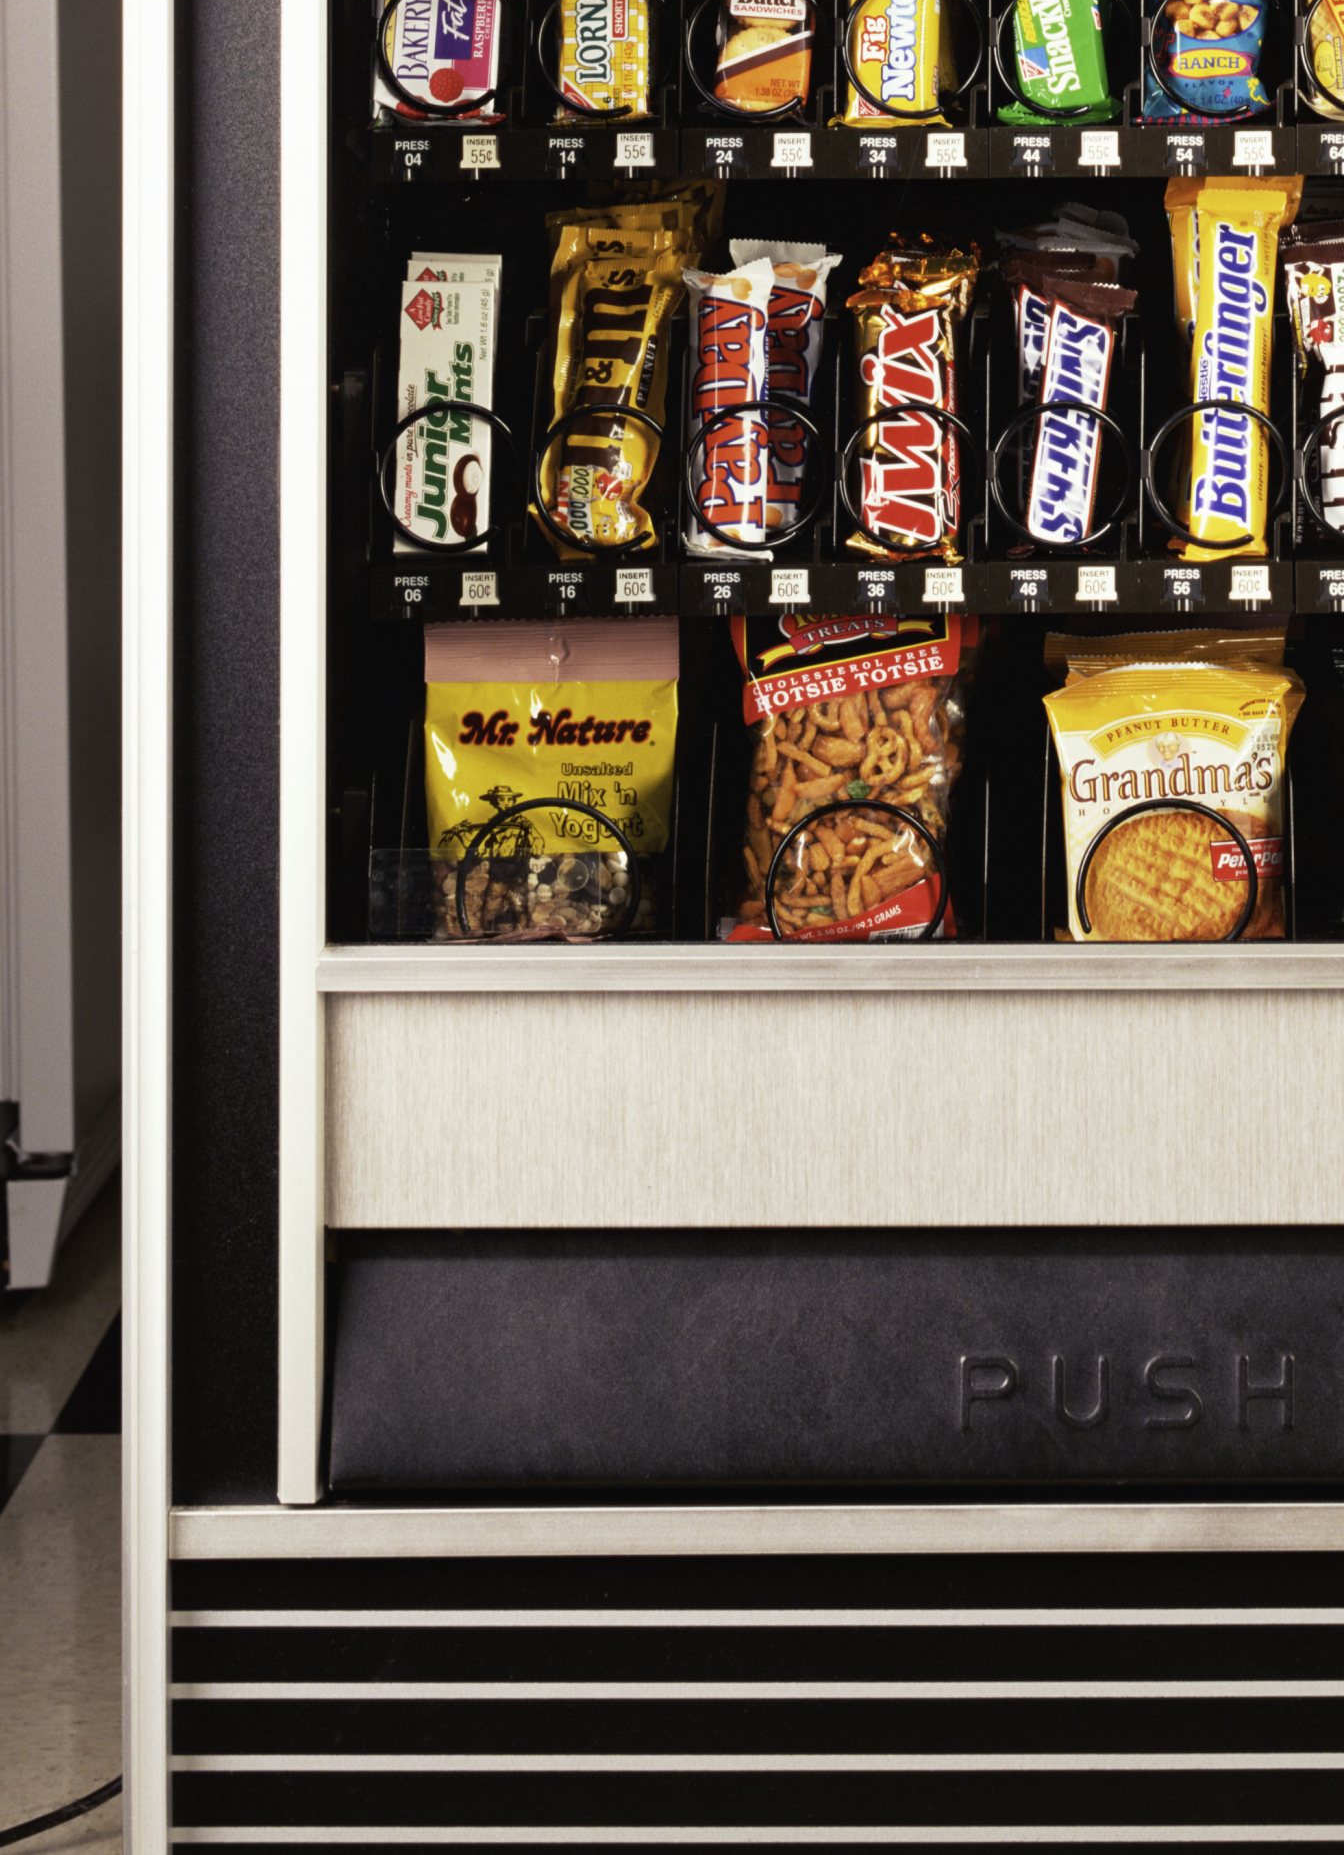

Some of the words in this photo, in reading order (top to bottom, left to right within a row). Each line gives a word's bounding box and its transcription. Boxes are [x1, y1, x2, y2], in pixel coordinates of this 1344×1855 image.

[733, 3, 804, 16] SANDWICHES
[860, 16, 888, 63] Fig
[448, 341, 474, 446] Mnts
[1195, 222, 1268, 528] Butterfinger
[417, 369, 451, 541] Junior
[704, 573, 740, 582] PRESS
[714, 585, 731, 598] 26
[773, 573, 802, 581] INSERT
[778, 583, 799, 597] 60¢
[803, 619, 885, 643] TREATS
[753, 659, 883, 695] CHOLESTEROL
[895, 647, 939, 662] FREE
[755, 678, 847, 713] HOTSIE
[855, 656, 943, 686] TOTSIE
[458, 711, 517, 746] Mr.
[530, 709, 652, 745] Nature
[1107, 720, 1162, 742] PEANUT
[1172, 718, 1231, 735] BUTTER
[561, 762, 633, 776] Unsalted
[1069, 752, 1275, 802] Grandma's
[960, 1354, 1295, 1432] PUSH
